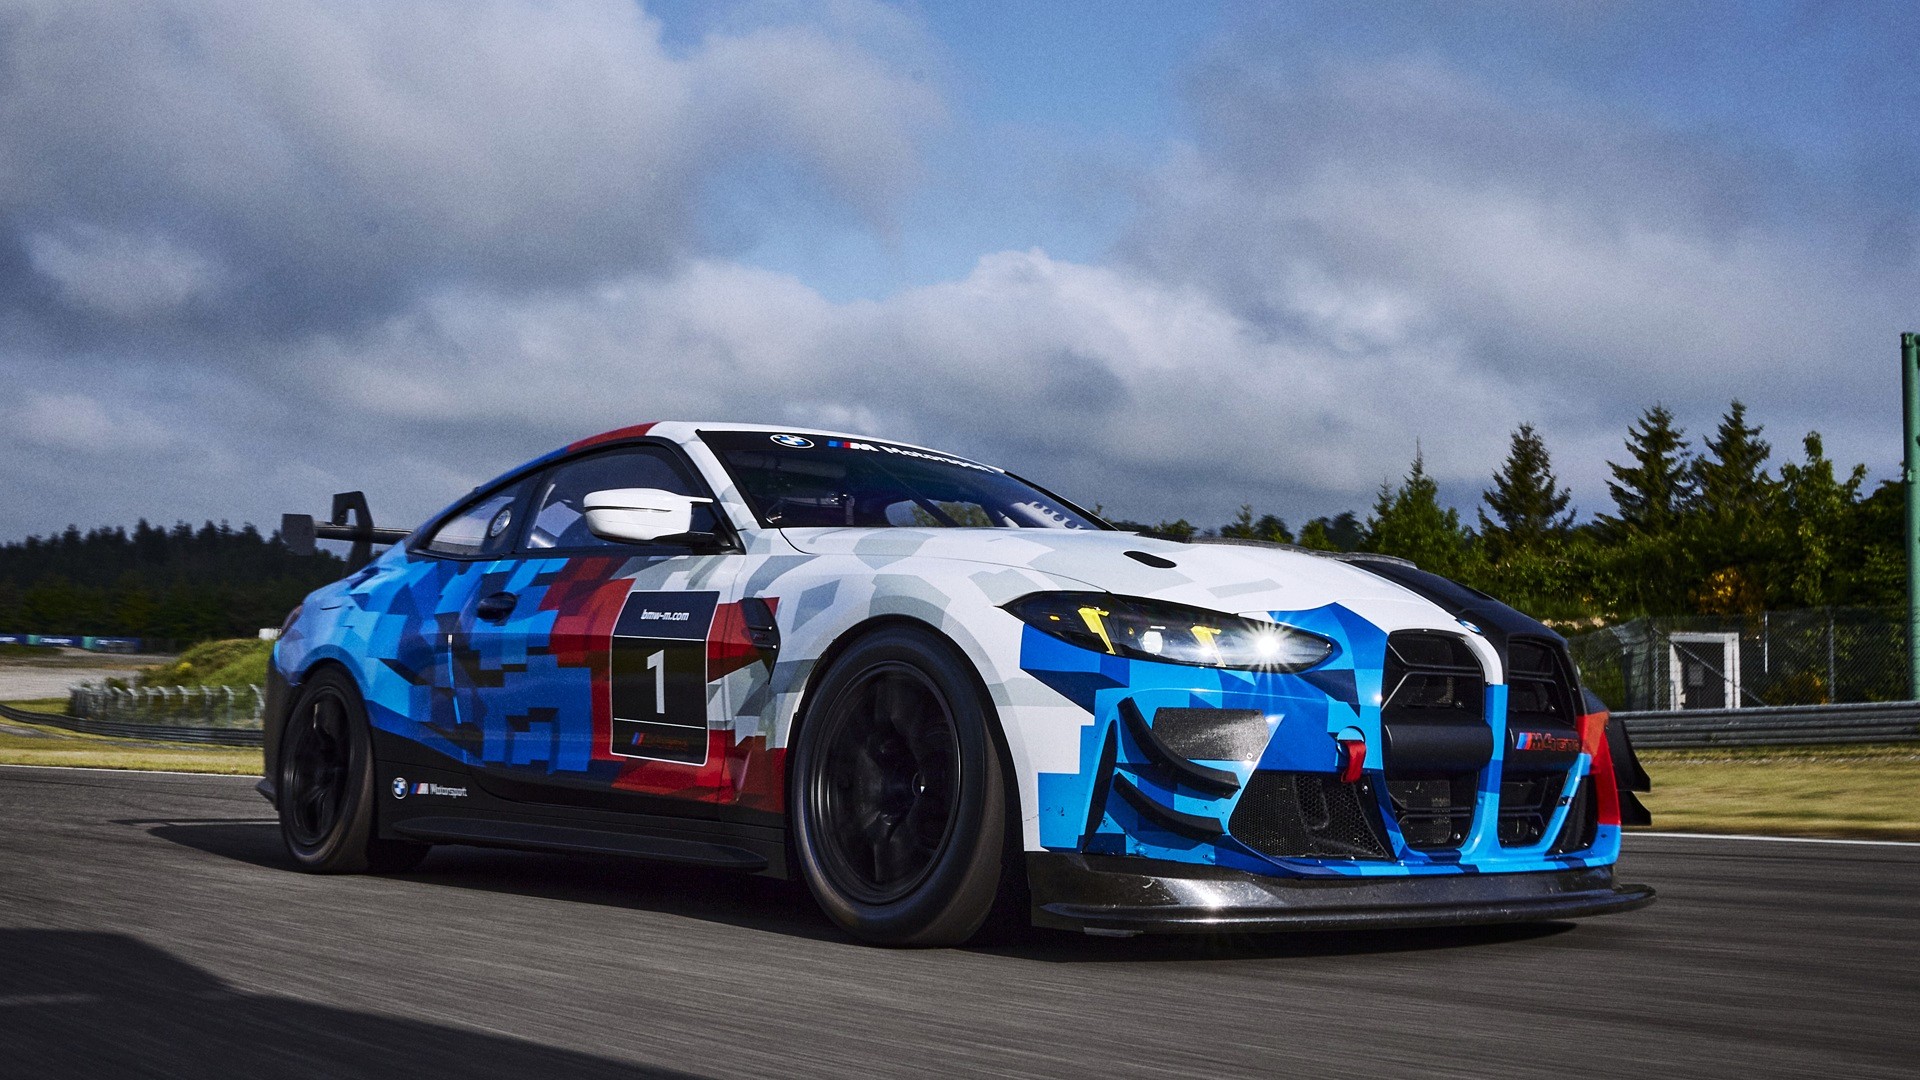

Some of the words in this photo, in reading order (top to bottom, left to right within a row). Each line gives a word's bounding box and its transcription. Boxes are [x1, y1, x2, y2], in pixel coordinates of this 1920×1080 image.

[641, 609, 690, 621] bmw-m.com
[647, 649, 666, 715] 1
[429, 783, 468, 799] Motorsport
